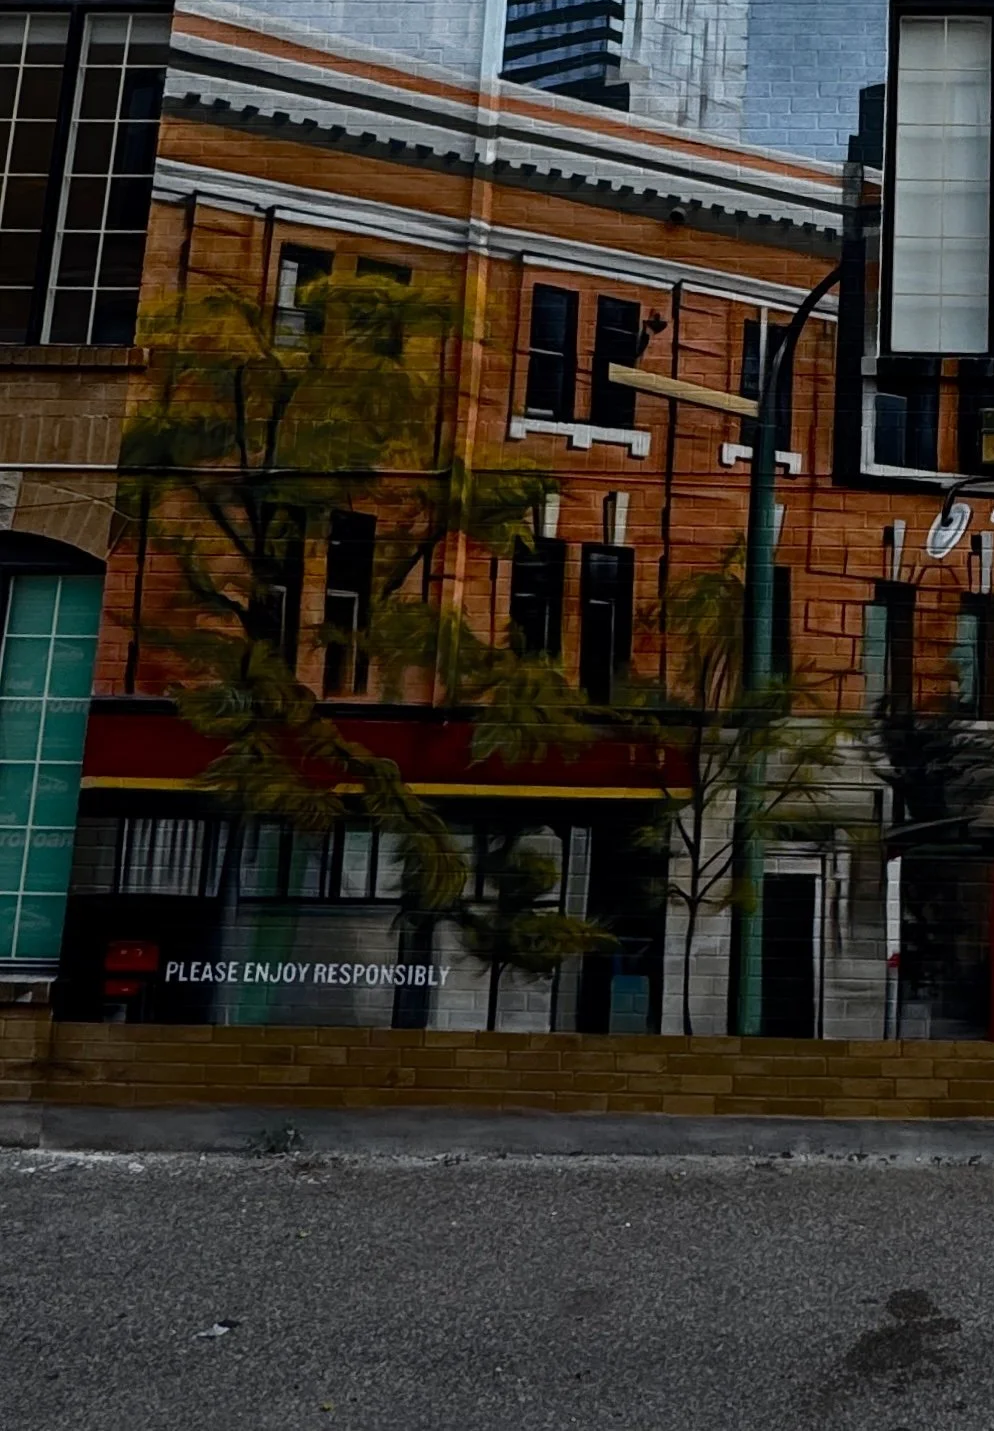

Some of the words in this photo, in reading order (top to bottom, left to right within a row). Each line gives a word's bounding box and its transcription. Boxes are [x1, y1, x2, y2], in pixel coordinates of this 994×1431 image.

[165, 961, 239, 982] PLEASE
[243, 962, 310, 983] ENJOY
[313, 963, 450, 986] RESPONSIBLY
